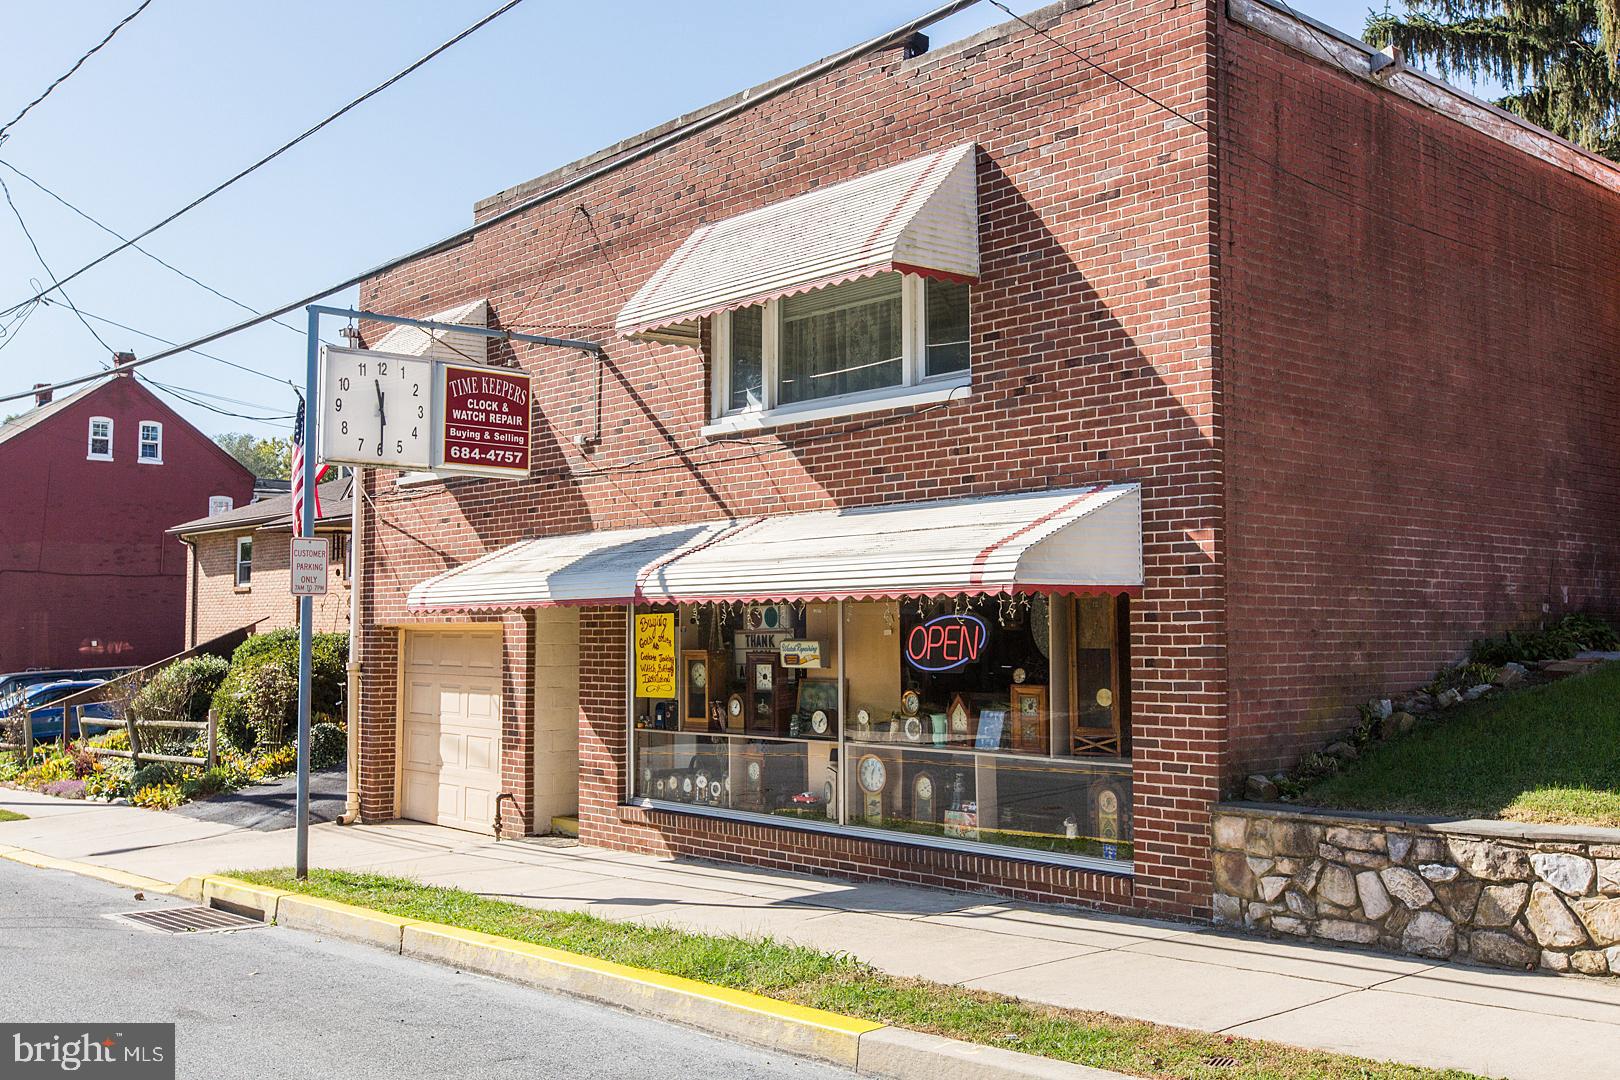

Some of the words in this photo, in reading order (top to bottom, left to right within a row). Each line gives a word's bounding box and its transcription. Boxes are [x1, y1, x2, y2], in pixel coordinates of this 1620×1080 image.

[358, 363, 367, 376] 11
[377, 362, 388, 376] 12
[400, 366, 405, 380] 1
[339, 377, 350, 391] 10
[412, 383, 419, 397] 2
[449, 376, 479, 398] TIME
[481, 376, 527, 406] KEEPERS
[335, 398, 343, 412] 9
[417, 405, 424, 419] 3
[467, 398, 499, 412] CLOCK
[501, 402, 509, 413] &
[452, 408, 485, 422] WATCH
[489, 413, 523, 426] REPAIR
[341, 420, 348, 435] 8
[411, 426, 418, 440] 4
[449, 427, 481, 441] Buying
[483, 431, 491, 440] &
[494, 432, 525, 445] Selling
[358, 438, 365, 452] 7
[376, 442, 384, 457] 6
[396, 440, 403, 454] 5
[450, 445, 524, 464] 684-4757
[294, 550, 326, 558] CUSTOMER
[296, 562, 323, 571] PARKING
[300, 576, 318, 584] ONLY
[744, 634, 776, 648] THANK
[908, 625, 980, 661] OPEN
